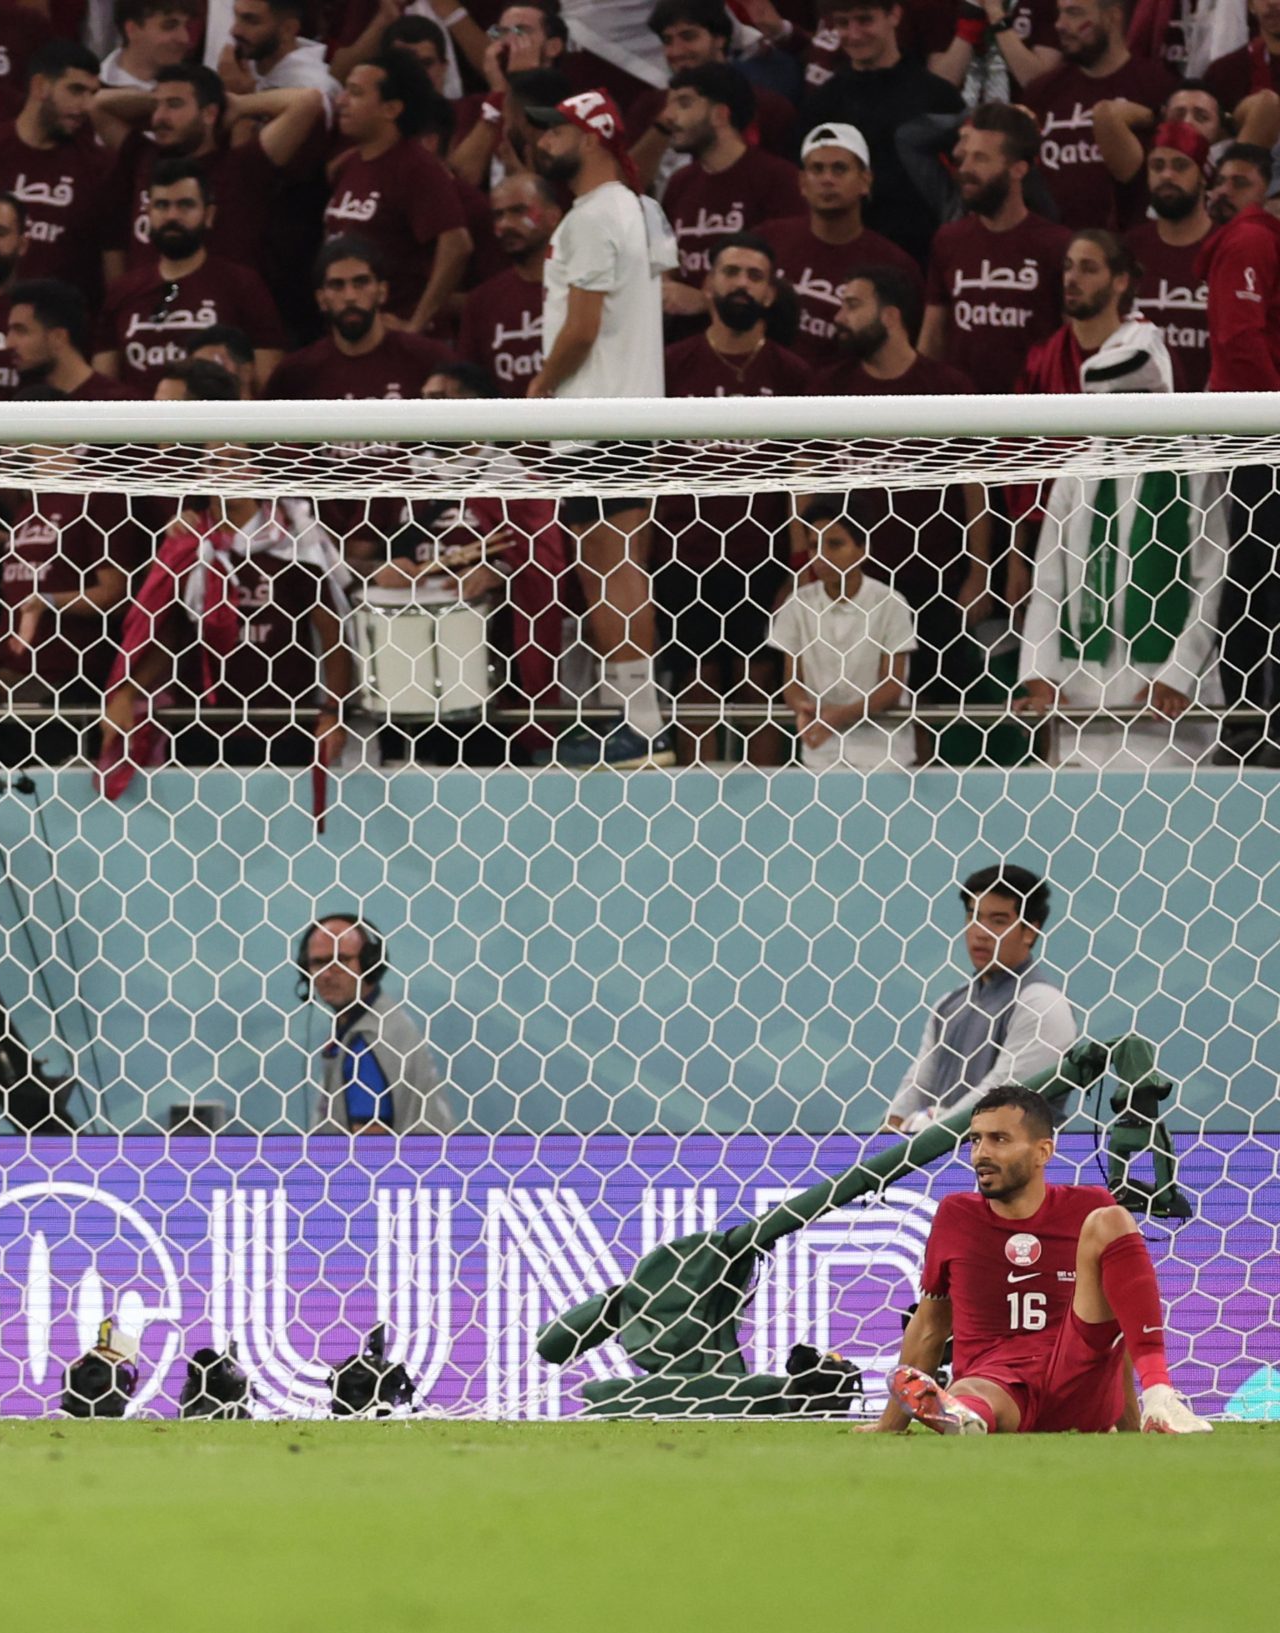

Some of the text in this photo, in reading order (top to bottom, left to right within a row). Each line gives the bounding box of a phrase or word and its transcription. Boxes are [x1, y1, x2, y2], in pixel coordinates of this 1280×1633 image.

[1040, 141, 1105, 170] Qata
[952, 259, 1039, 297] قطر
[954, 301, 1034, 332] Qatar
[1007, 1291, 1047, 1331] 16
